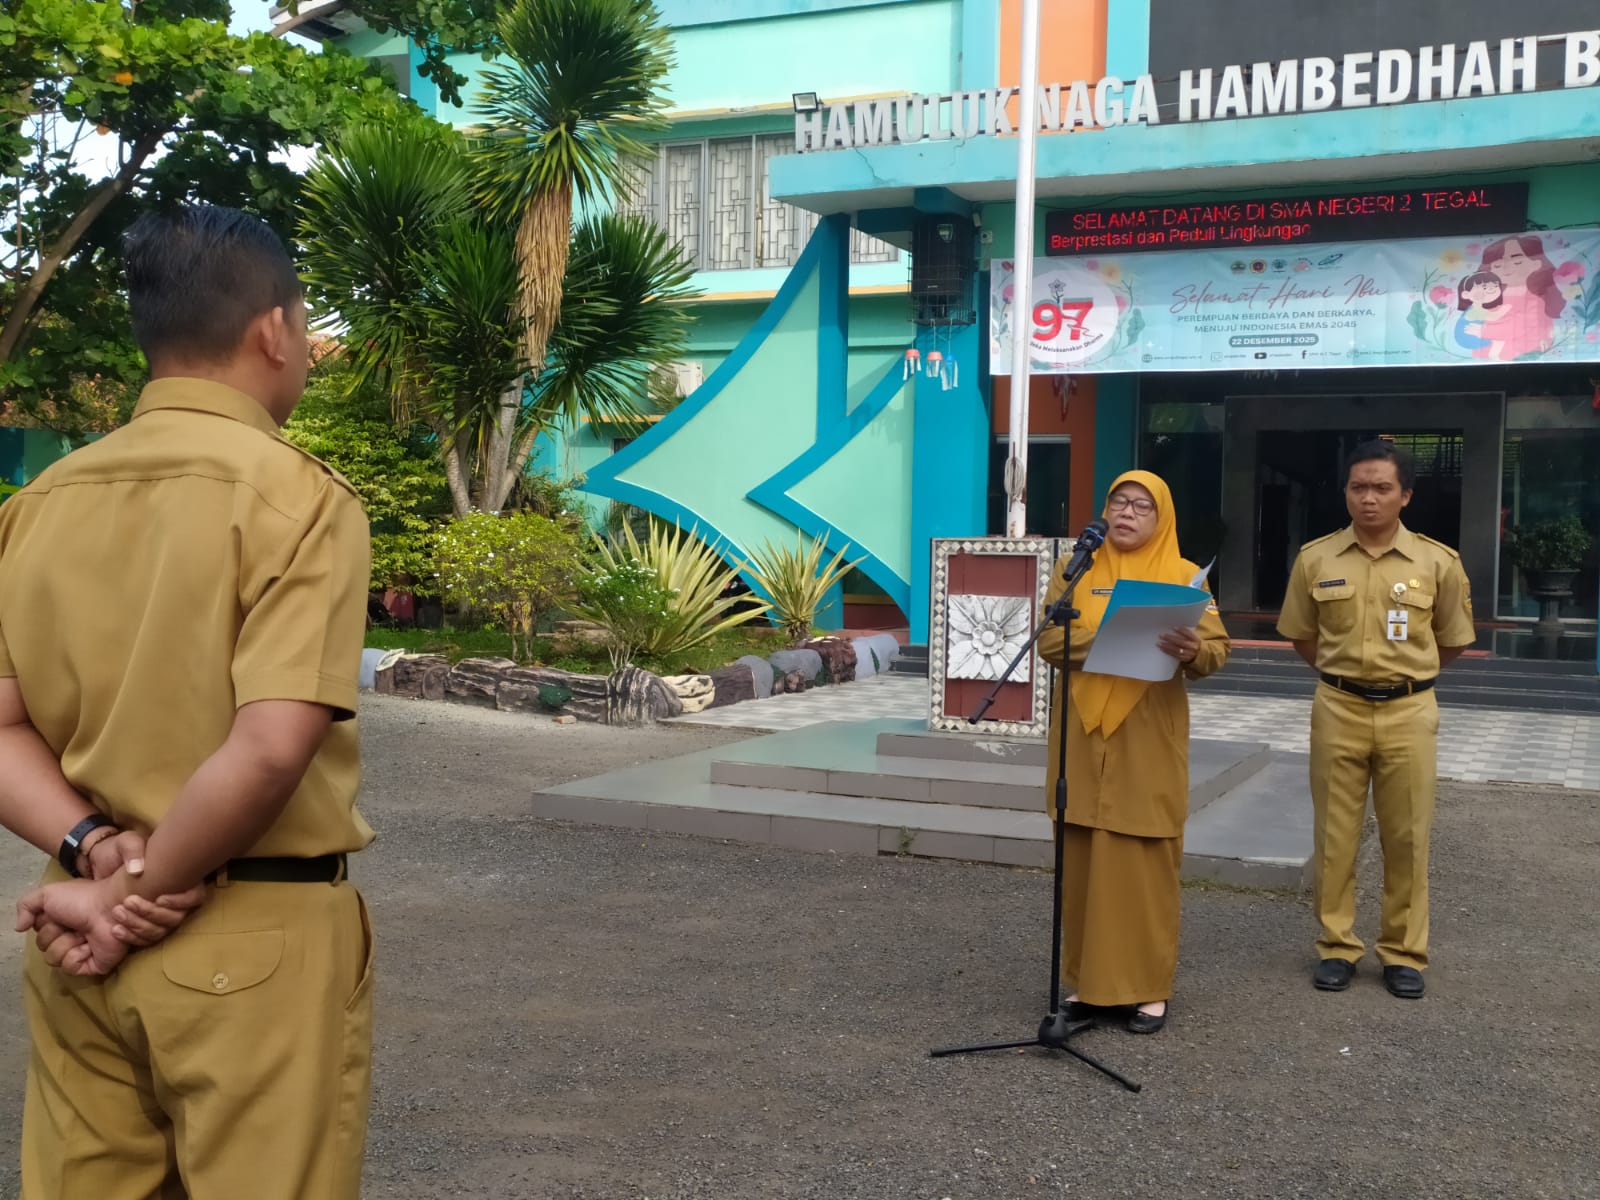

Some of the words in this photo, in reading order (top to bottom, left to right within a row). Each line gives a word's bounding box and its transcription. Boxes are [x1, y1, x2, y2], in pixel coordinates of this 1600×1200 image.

[795, 87, 1014, 153] HAMULUK
[1036, 74, 1161, 131] NAGA
[1178, 35, 1538, 122] HAMBEDHAH
[1072, 209, 1160, 231] SELAMAT
[1162, 204, 1242, 226] DATANG
[1246, 203, 1265, 220] DI
[1269, 201, 1313, 220] SMA
[1317, 195, 1395, 217] NEGERI
[1399, 193, 1412, 212] 2
[1421, 189, 1492, 211] TEGAL
[1050, 230, 1133, 250] Berprestasi
[1136, 230, 1165, 245] dan
[1169, 227, 1216, 243] Peduli
[1169, 281, 1270, 314] Selamat
[1268, 276, 1336, 310] Hari
[1343, 274, 1389, 305] Ibu
[1031, 297, 1094, 342] 97
[1177, 313, 1239, 323] PEREMPUAN
[1241, 311, 1290, 321] BERDAYA
[1292, 311, 1315, 319] DAN
[1194, 323, 1238, 333] MENUJU
[1239, 322, 1297, 332] INDONESIA
[1299, 321, 1328, 330] EMAS
[1330, 320, 1357, 329] 2045
[1231, 337, 1242, 345] 22
[1243, 337, 1293, 345] DESEMBER
[1293, 336, 1316, 344] 2025
